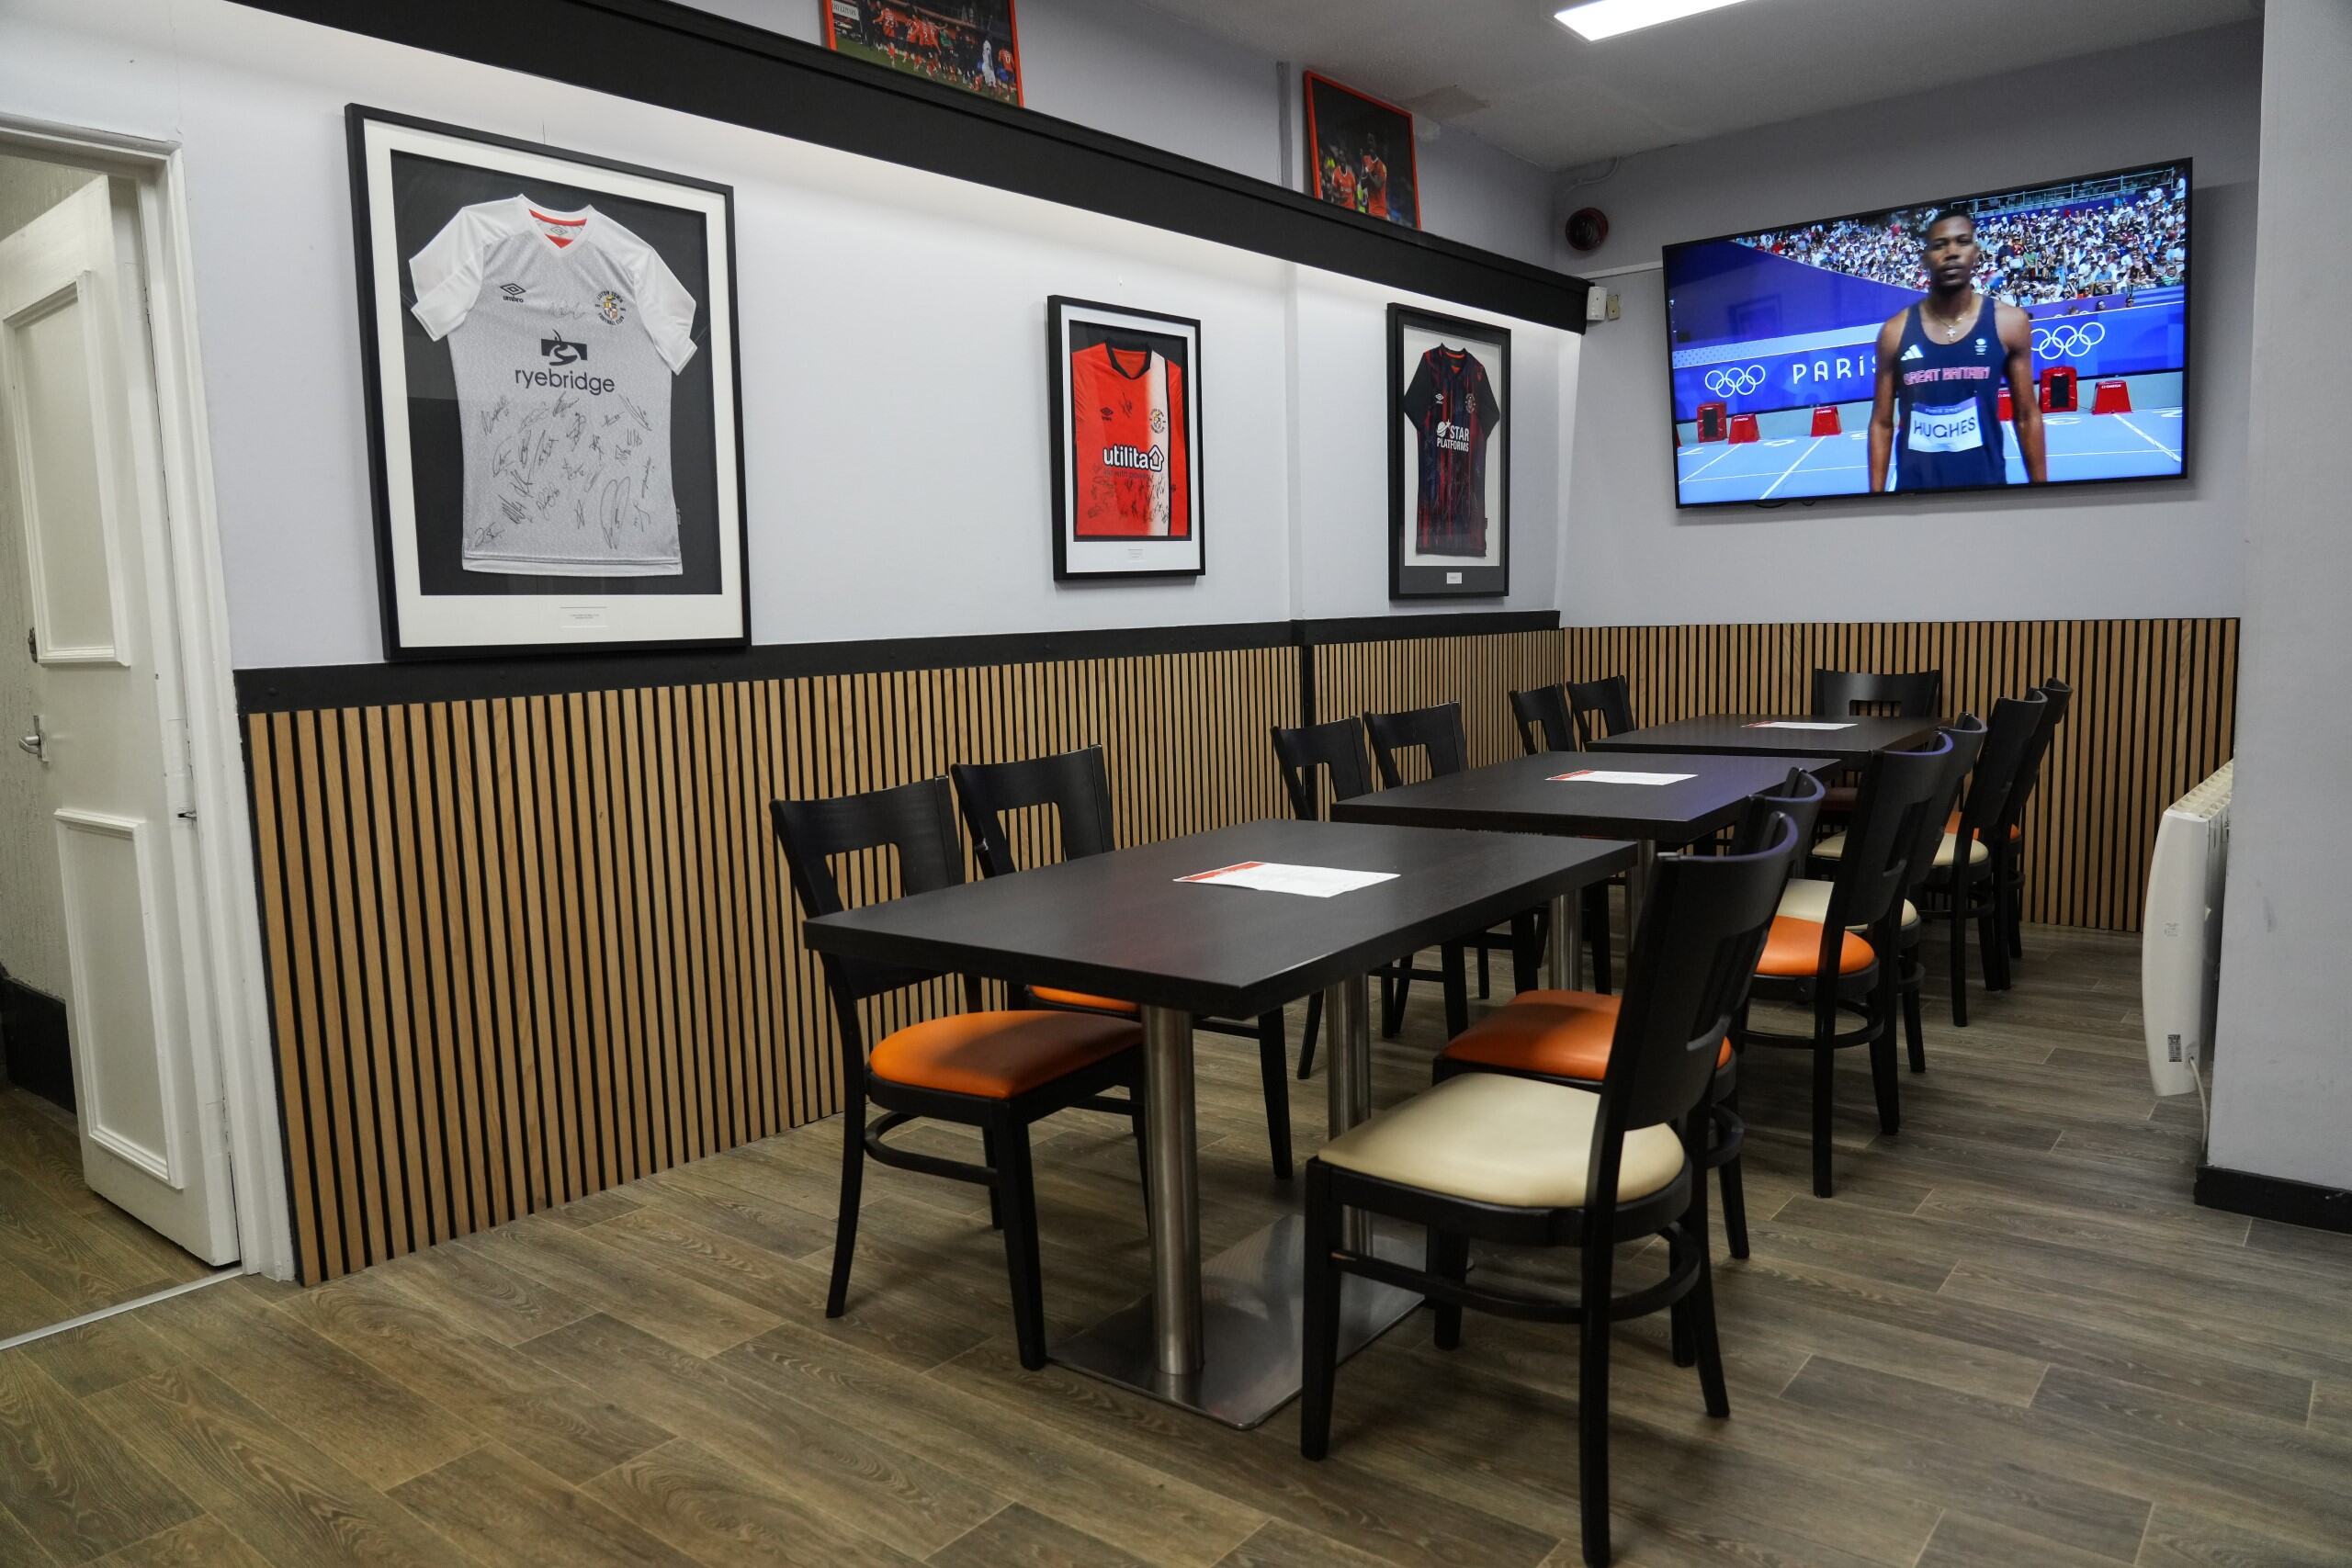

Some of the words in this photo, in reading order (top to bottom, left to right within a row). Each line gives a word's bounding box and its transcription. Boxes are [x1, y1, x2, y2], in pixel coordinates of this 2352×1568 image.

[503, 295, 524, 303] umbro
[514, 368, 615, 396] ryebridge
[1904, 368, 1941, 385] GREAT
[1942, 367, 1991, 380] BRITAIN
[1450, 425, 1469, 441] STAR
[1914, 416, 1976, 438] HUGHES
[1437, 437, 1469, 452] PLATFORMS
[1102, 444, 1149, 469] utilita
